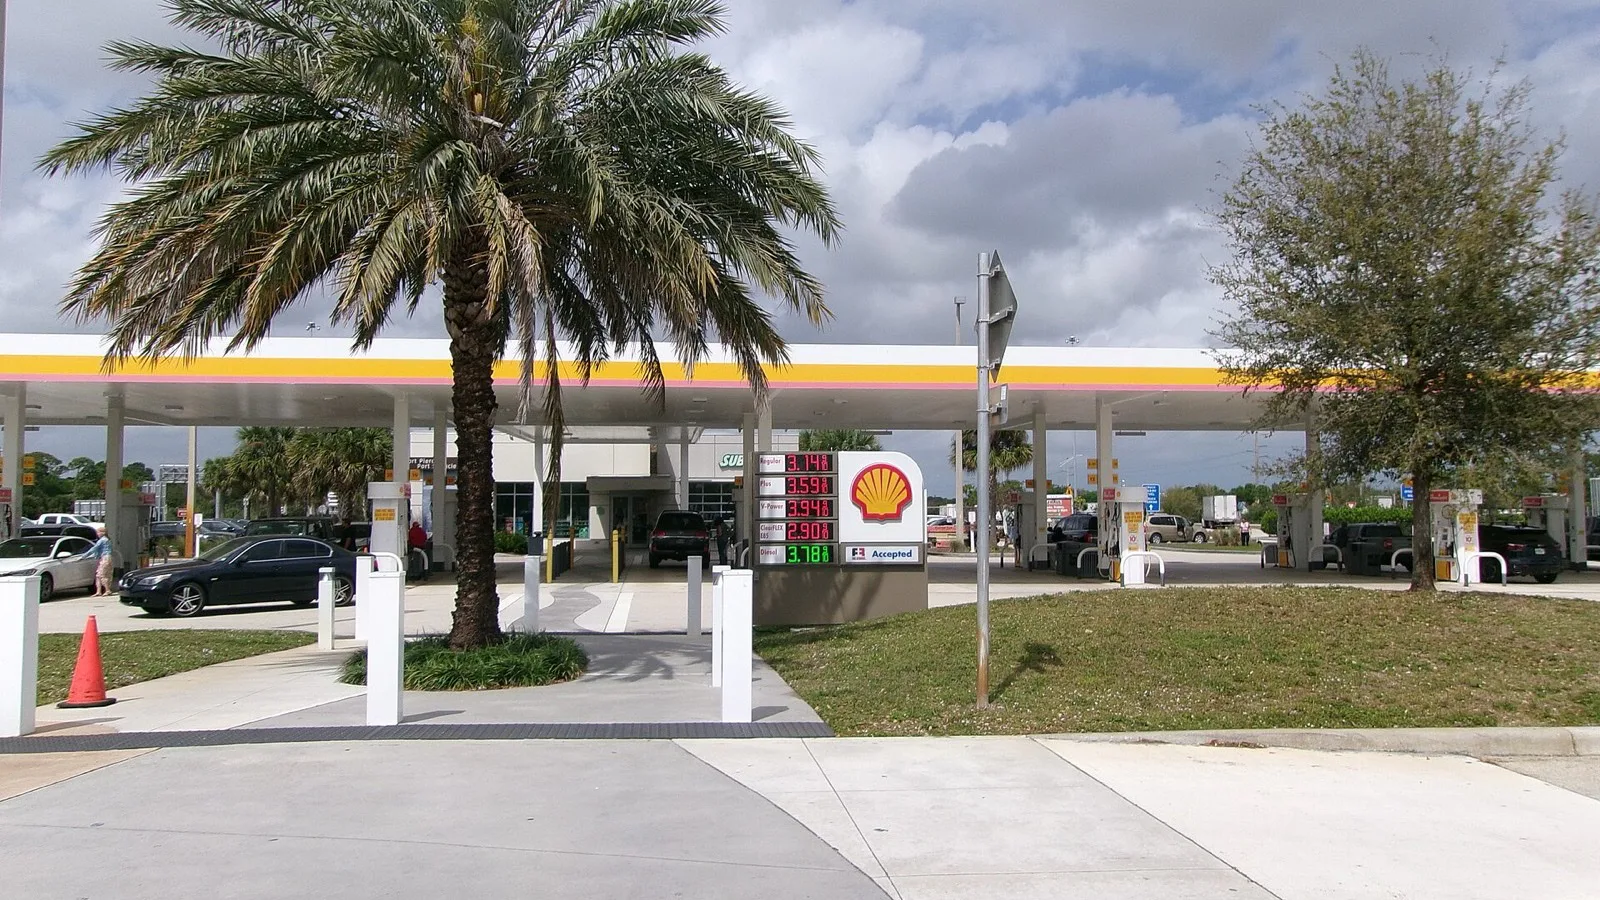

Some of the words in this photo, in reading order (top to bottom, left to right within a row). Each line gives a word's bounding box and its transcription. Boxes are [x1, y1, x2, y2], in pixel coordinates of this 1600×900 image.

[719, 453, 743, 467] SUB
[760, 457, 781, 466] Regular
[872, 549, 912, 560] Accepted
